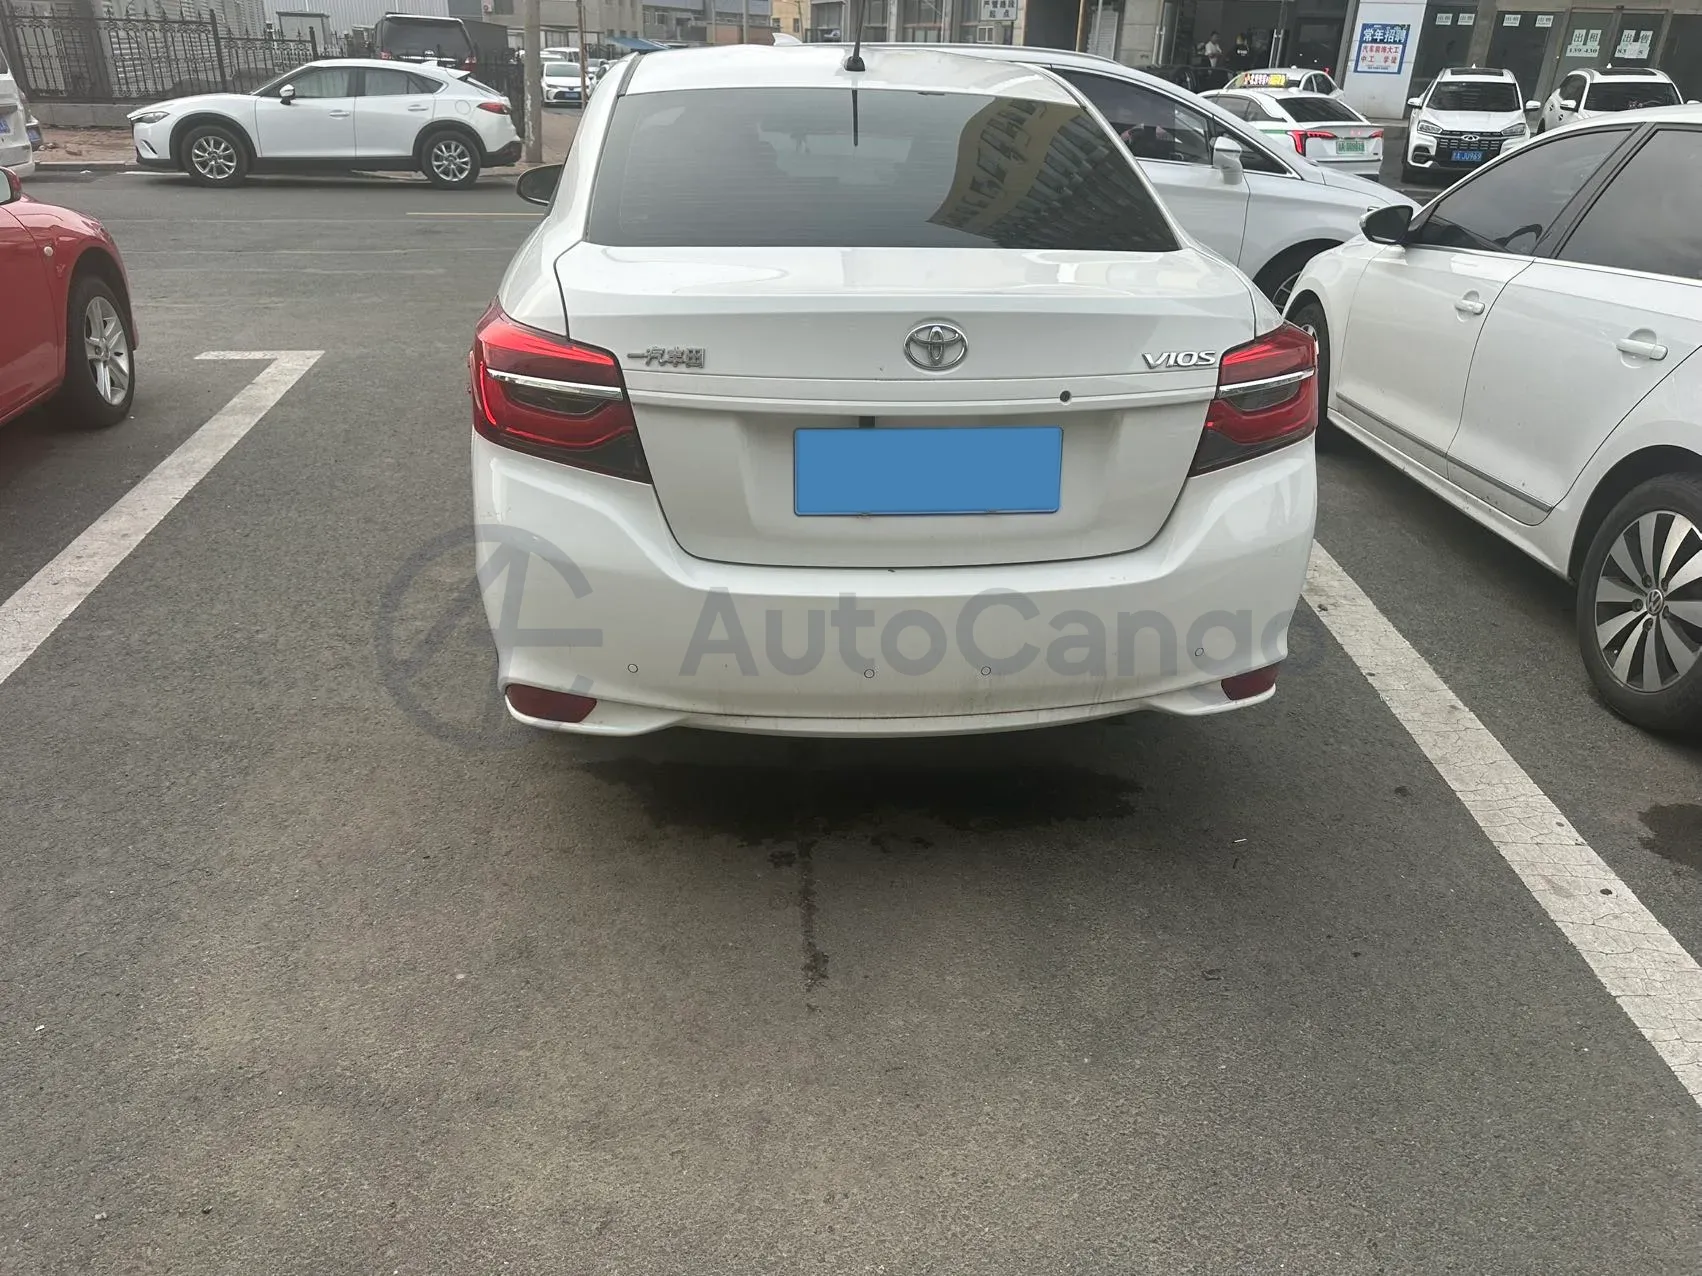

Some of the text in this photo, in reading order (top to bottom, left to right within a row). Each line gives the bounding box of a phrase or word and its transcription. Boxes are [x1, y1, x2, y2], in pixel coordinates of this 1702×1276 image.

[627, 346, 705, 368] 一汽丰田
[1141, 350, 1217, 369] VIOS
